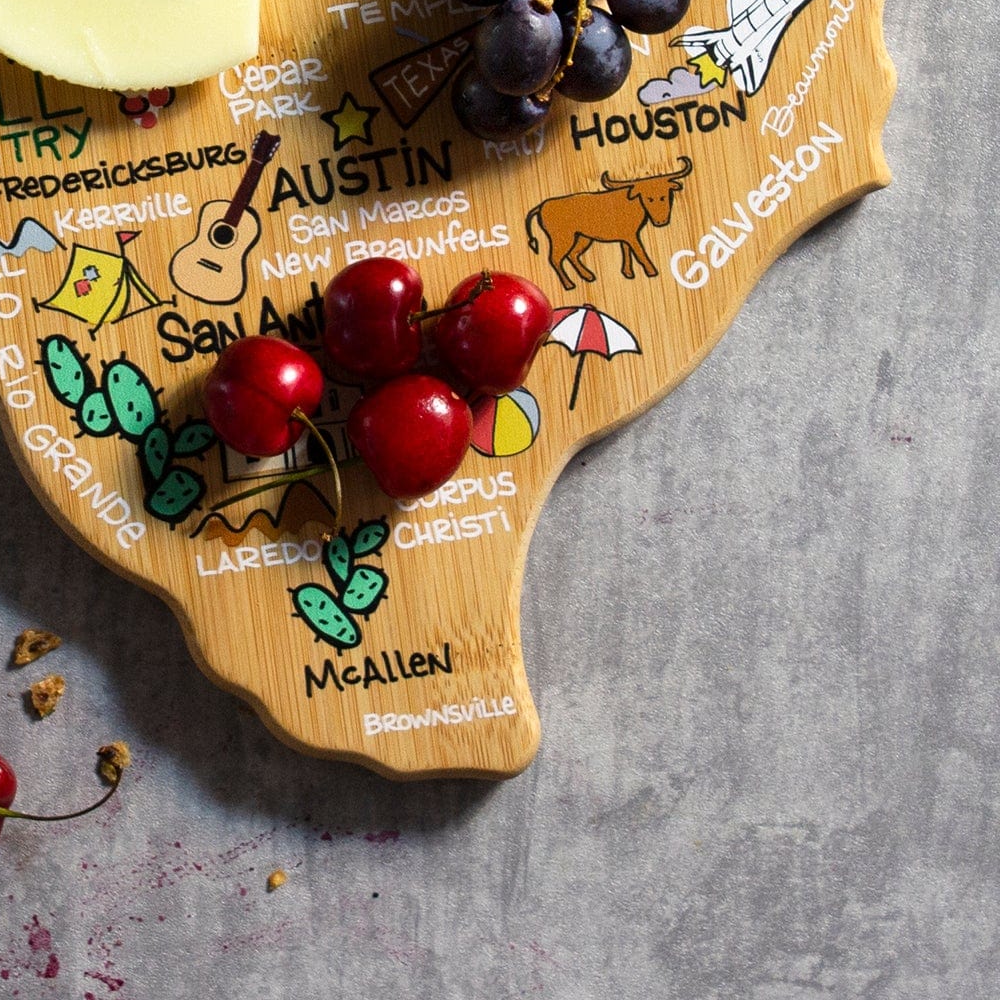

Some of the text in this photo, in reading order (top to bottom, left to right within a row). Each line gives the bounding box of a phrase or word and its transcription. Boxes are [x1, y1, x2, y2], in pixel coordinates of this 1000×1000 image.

[228, 92, 321, 125] PARK
[571, 91, 750, 151] HOUSTON
[196, 539, 324, 576] LAREDO
